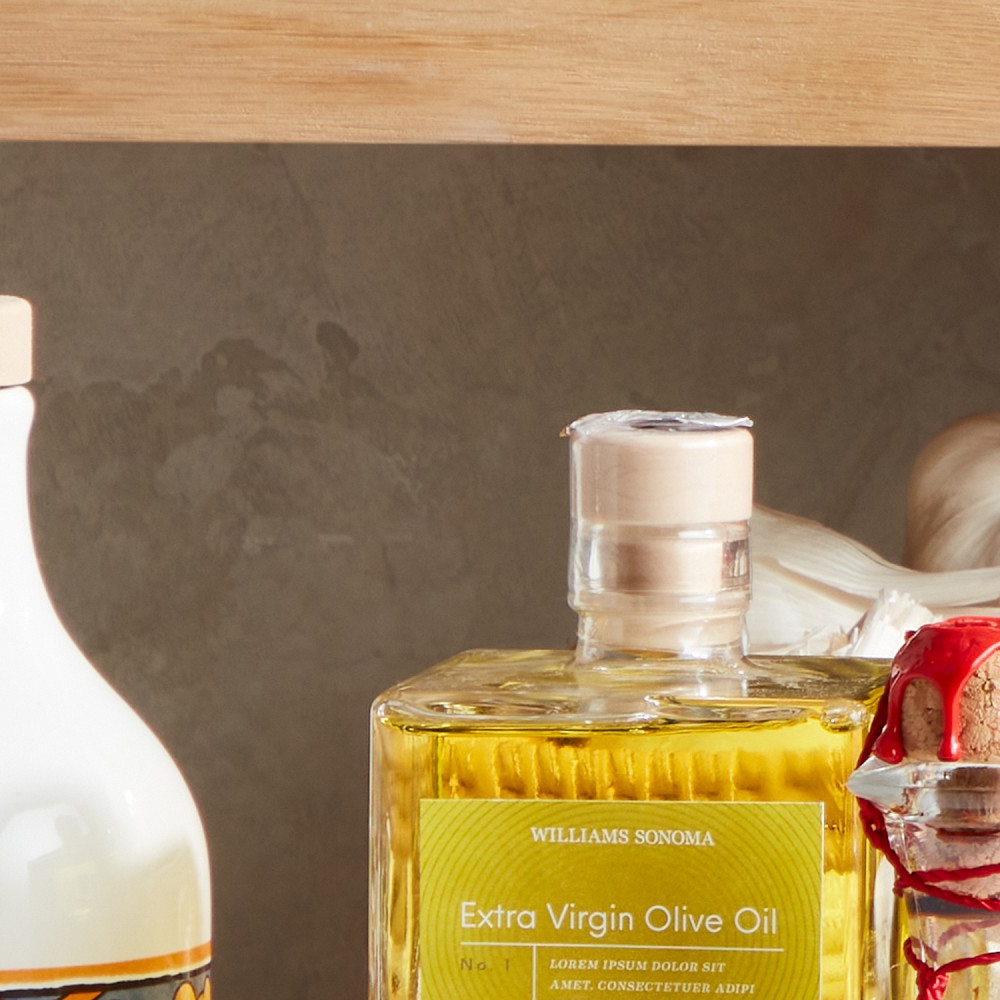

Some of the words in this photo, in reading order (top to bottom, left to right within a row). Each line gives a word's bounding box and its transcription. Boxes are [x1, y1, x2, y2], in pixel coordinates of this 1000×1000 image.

[530, 826, 629, 845] WILLIAMS
[634, 828, 715, 847] SONOMA
[460, 901, 535, 930] Extra
[547, 902, 633, 938] Virgin
[645, 905, 723, 934] Olive
[734, 907, 777, 934] Oil
[549, 958, 599, 970] LOREM
[602, 960, 647, 971] IPSUM
[651, 961, 698, 972] DOLOR
[702, 962, 726, 973] SIT
[597, 980, 711, 993] CONSECTETUER
[715, 983, 755, 994] ADIPI
